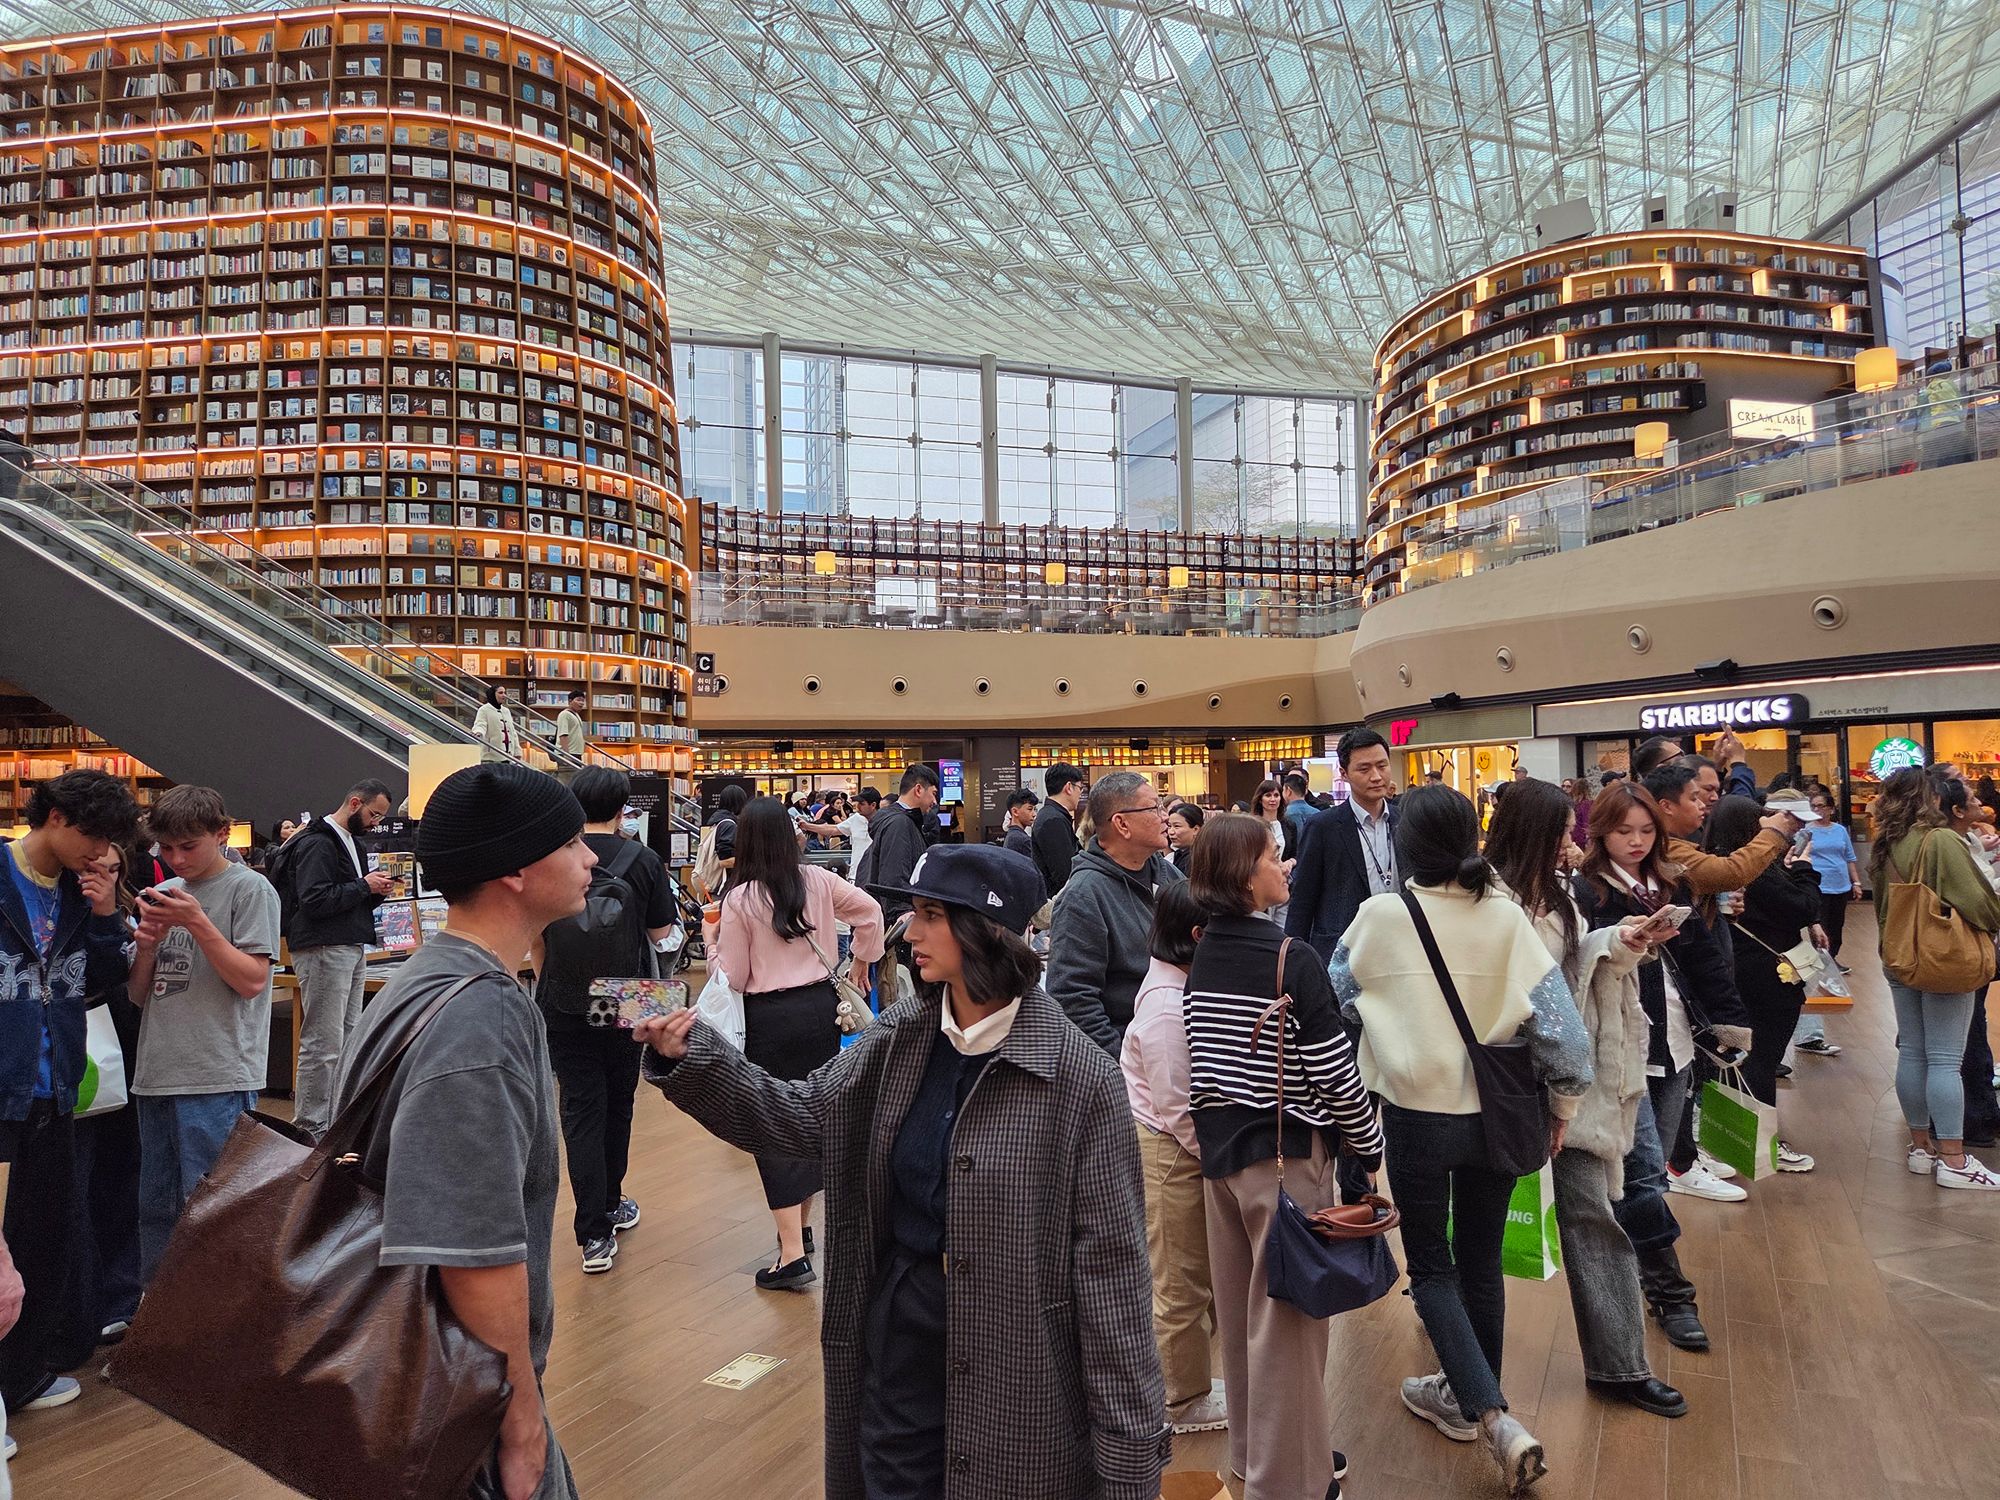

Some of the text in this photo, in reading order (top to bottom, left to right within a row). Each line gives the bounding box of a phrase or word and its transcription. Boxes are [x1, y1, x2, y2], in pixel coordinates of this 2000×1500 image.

[1737, 411, 1807, 425] CREAM LABEL
[527, 654, 533, 672] C
[699, 656, 711, 671] C
[1641, 698, 1790, 729] STARBUCKS
[382, 905, 412, 915] opGear
